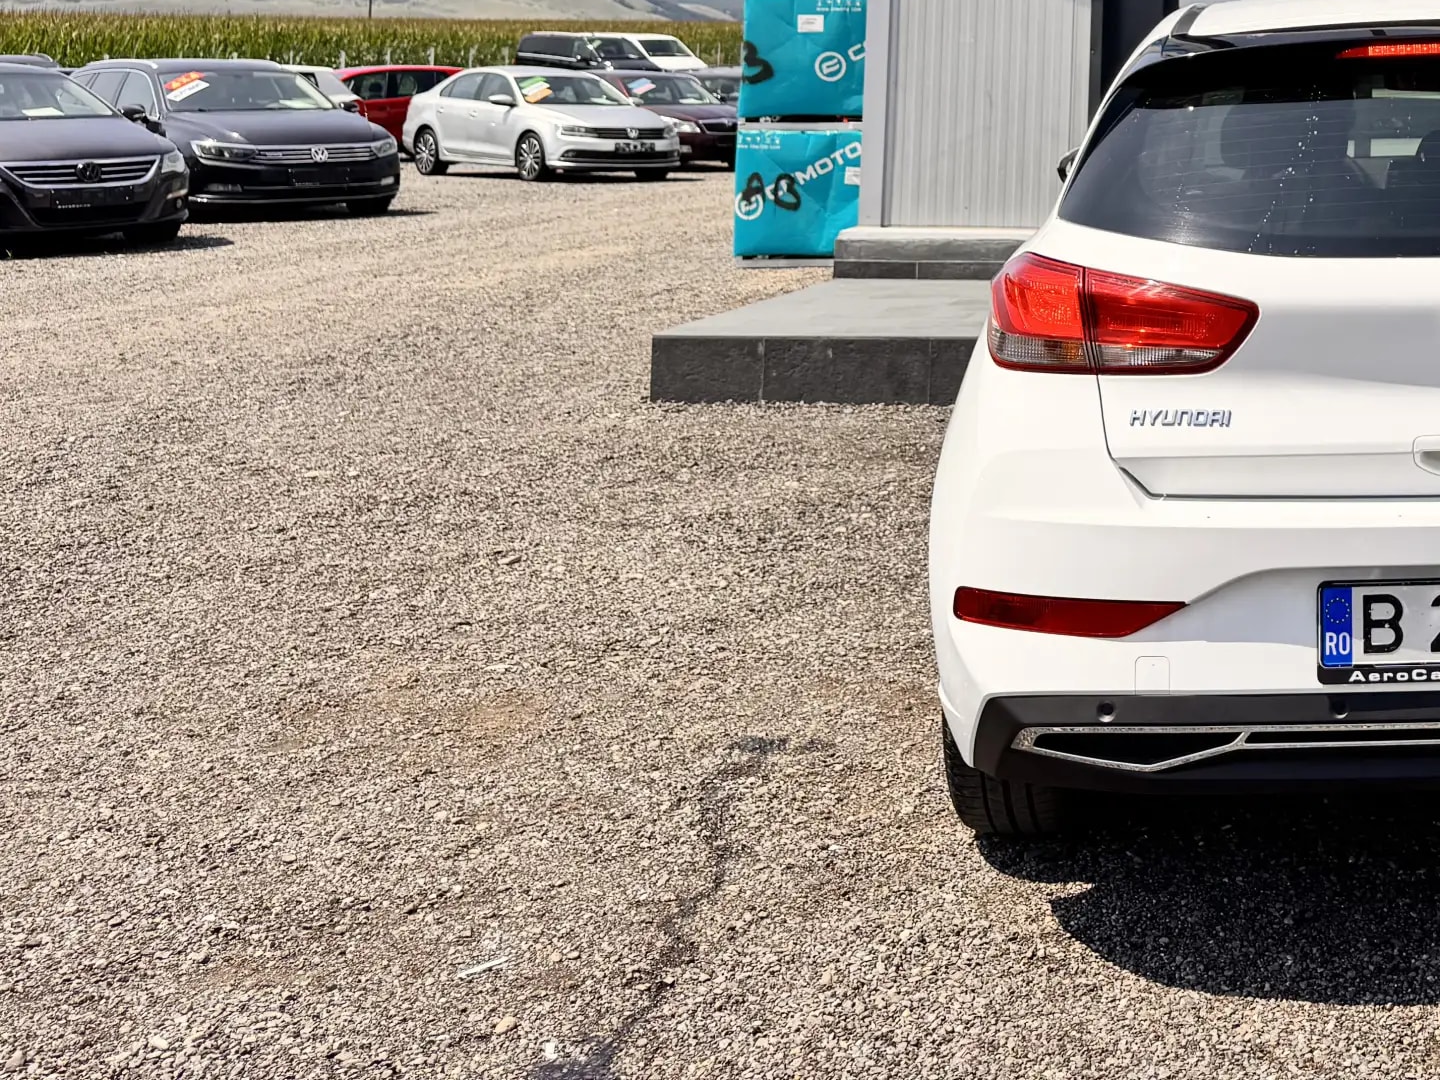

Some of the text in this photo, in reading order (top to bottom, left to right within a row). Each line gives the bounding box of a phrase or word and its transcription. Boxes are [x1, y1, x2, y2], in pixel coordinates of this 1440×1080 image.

[1129, 409, 1232, 427] HYUNDAI
[1362, 594, 1404, 654] B
[1325, 631, 1350, 657] RO
